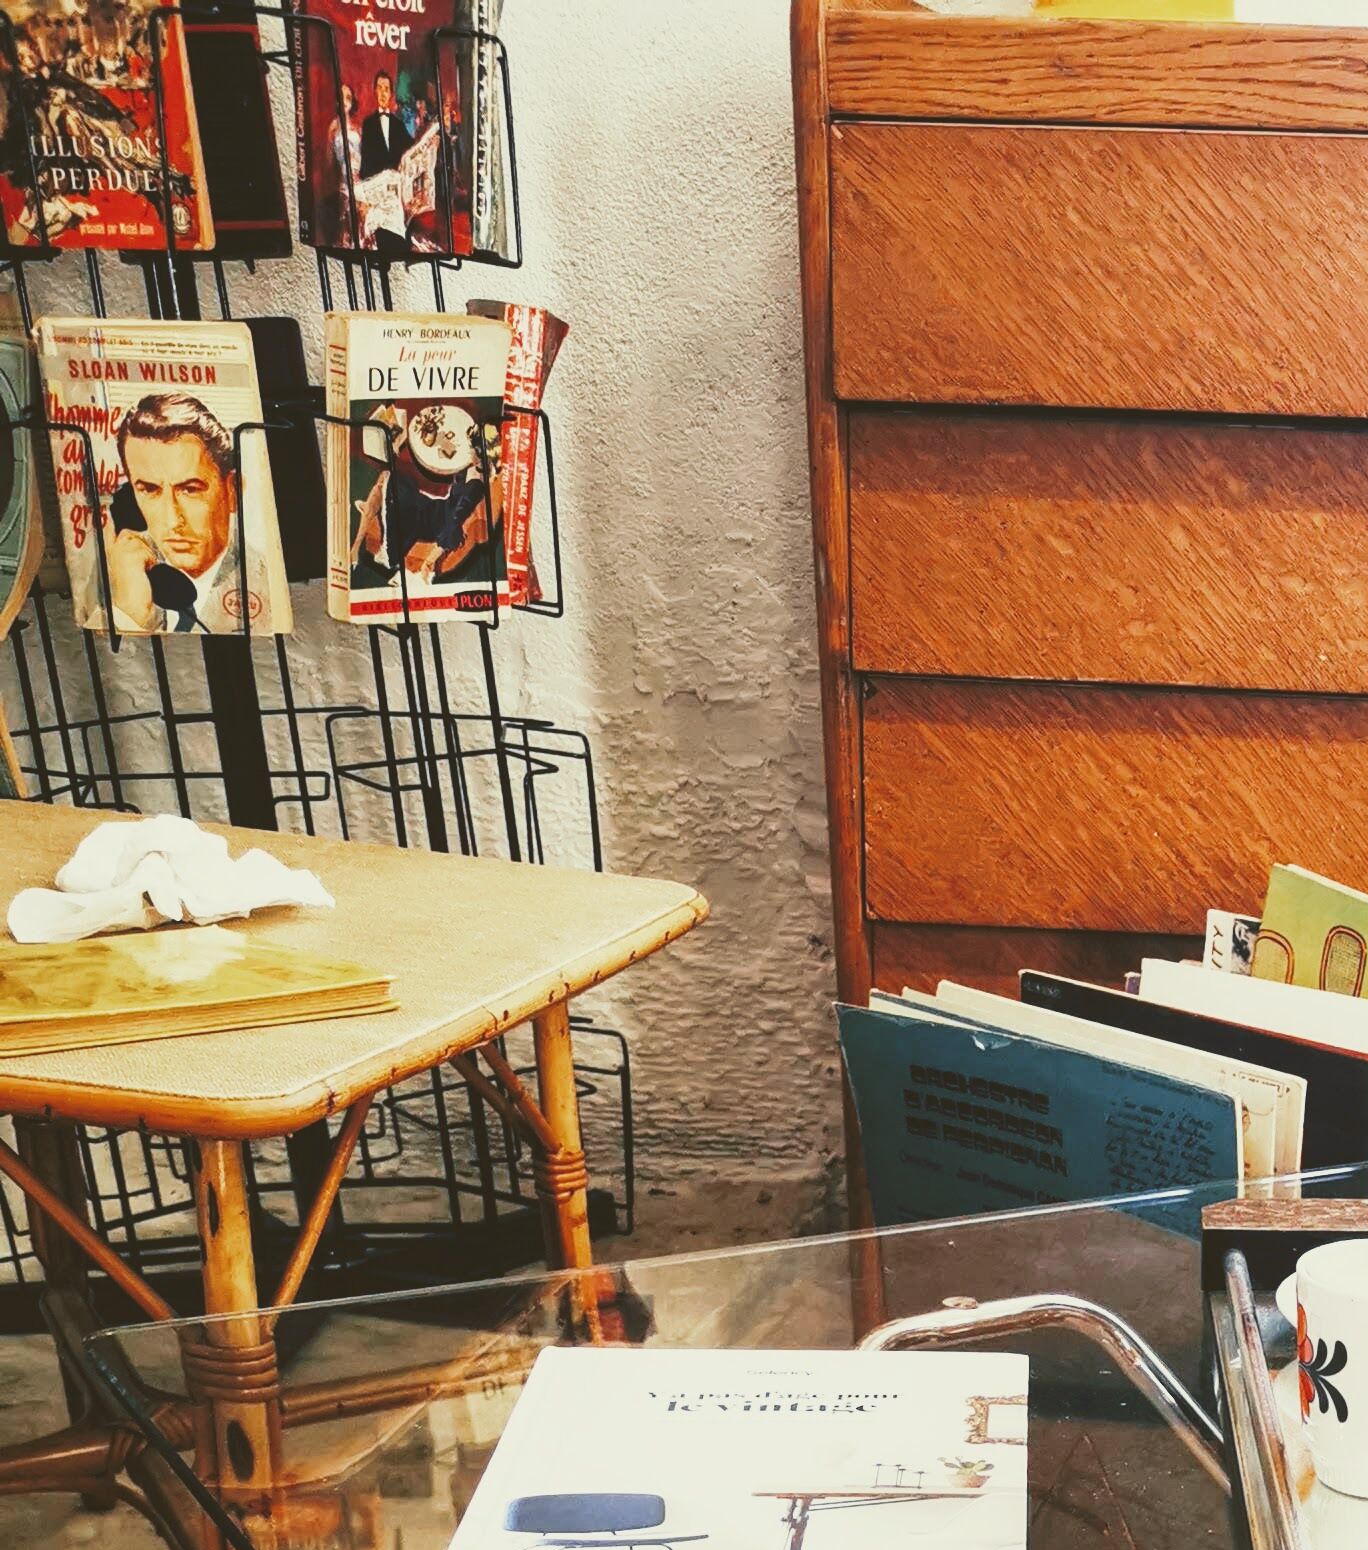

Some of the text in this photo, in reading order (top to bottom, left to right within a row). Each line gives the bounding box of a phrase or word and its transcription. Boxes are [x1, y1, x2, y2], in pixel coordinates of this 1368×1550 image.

[355, 12, 410, 50] rêver
[297, 86, 306, 138] Cesbron
[297, 141, 306, 182] Gilbert
[51, 168, 169, 192] PERDUE
[382, 328, 472, 340] HENRY BORDEAUX
[398, 346, 457, 365] La peur
[68, 358, 217, 384] SLOAN WILSON
[368, 367, 399, 392] DE
[412, 366, 480, 391] VIVRE
[56, 459, 126, 494] comlet
[70, 504, 108, 549] grs
[515, 520, 526, 553] JESSEN
[460, 593, 493, 608] PLON
[667, 1400, 878, 1414] le vintage
